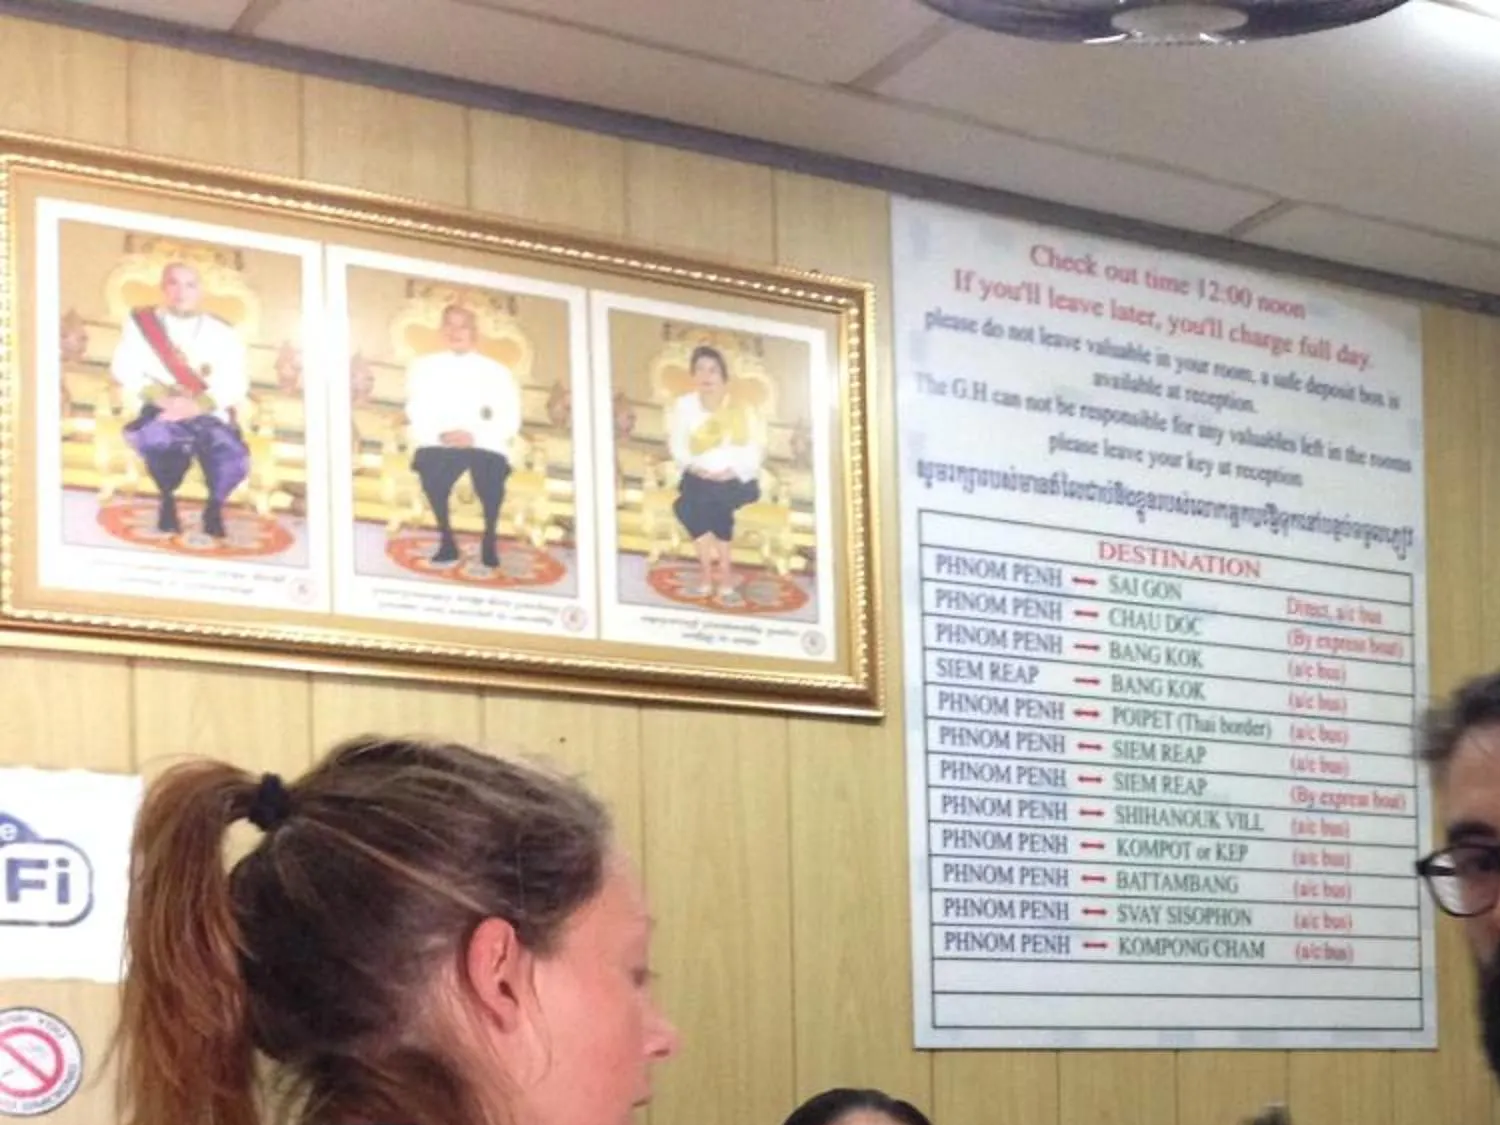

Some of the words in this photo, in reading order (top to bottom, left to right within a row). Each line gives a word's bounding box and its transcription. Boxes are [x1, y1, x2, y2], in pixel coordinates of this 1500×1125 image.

[1030, 245, 1097, 275] Check
[1104, 264, 1138, 285] out
[1145, 271, 1190, 296] time
[1198, 278, 1253, 308] 12:00
[1257, 294, 1307, 319] noon
[954, 268, 975, 292] If
[979, 279, 1041, 305] you'll
[1049, 286, 1104, 317] leave
[1109, 298, 1162, 331] later,
[1168, 313, 1224, 339] you'll
[1229, 323, 1294, 357] charge
[1299, 335, 1332, 361] full
[925, 306, 979, 334] please
[981, 316, 1004, 338] do
[1008, 324, 1035, 343] not
[1038, 325, 1082, 351] leave
[1086, 337, 1152, 365] valuable
[1155, 350, 1171, 367] in
[1174, 355, 1209, 374] your
[1260, 372, 1270, 386] a
[1273, 372, 1303, 391] safe
[1305, 375, 1356, 401] deposit
[1388, 395, 1400, 411] is
[1092, 371, 1162, 397] available
[1166, 383, 1181, 400] at
[916, 371, 947, 396] The
[951, 377, 988, 402] G.H
[991, 390, 1022, 408] can
[1025, 394, 1052, 413] not
[1056, 395, 1077, 417] be
[1079, 403, 1168, 432] responsible
[1172, 415, 1194, 436] for
[1197, 424, 1224, 446] any
[1229, 428, 1298, 453] valuables
[1300, 434, 1324, 458] left
[1327, 441, 1342, 461] in
[1345, 444, 1367, 465] the
[1369, 453, 1412, 473] rooms
[1048, 432, 1099, 455] please
[1103, 438, 1143, 462] leave
[1148, 450, 1183, 468] your
[1186, 450, 1213, 478] key
[1217, 460, 1232, 477] at
[935, 553, 1007, 581] PHNOM
[1012, 563, 1063, 588] PENH
[1098, 541, 1262, 578] DESTINATION
[935, 588, 1007, 615] PHNOM
[1012, 597, 1063, 622] PENH
[1107, 606, 1161, 632] CHAU
[1165, 613, 1204, 637] DOC
[935, 622, 1008, 649] PHNOM
[1012, 630, 1063, 655] PENH
[1286, 627, 1312, 651] (By
[1316, 636, 1367, 655] express
[1108, 640, 1161, 664] BANG
[1165, 646, 1204, 669] KOK
[935, 656, 984, 681] SIEM
[989, 663, 1040, 685] REAP
[1111, 673, 1162, 697] BANG
[1167, 678, 1206, 701] KOK
[938, 690, 1010, 717] PHNOM
[1014, 697, 1065, 721] PENH
[1112, 705, 1174, 731] POIPET
[1176, 711, 1216, 734] (Thai
[1218, 714, 1272, 741] border)
[939, 725, 1011, 750] PHNOM
[1015, 730, 1066, 753] PENH
[1112, 739, 1157, 762] SIEM
[1161, 743, 1208, 765] REAP
[940, 759, 1012, 785] PHNOM
[1015, 765, 1067, 788] PENH
[1112, 771, 1157, 794] SIEM
[1161, 775, 1209, 797] REAP
[941, 793, 1012, 818] PHNOM
[1017, 798, 1068, 821] PENH
[1319, 791, 1370, 809] express
[1114, 804, 1221, 830] SHIHANOUK
[1225, 811, 1265, 832] VILL
[942, 828, 1013, 851] PHNOM
[1018, 832, 1069, 854] PENH
[1115, 837, 1192, 861] KOMPOT
[1196, 846, 1212, 862] or
[1215, 842, 1250, 863] KEP
[5, 857, 70, 904] Fi
[943, 862, 1014, 885] PHNOM
[1019, 865, 1069, 888] PENH
[1115, 870, 1240, 895] BATTAMBANG
[943, 897, 1015, 920] PHNOM
[1019, 899, 1070, 922] PENH
[1116, 903, 1163, 925] SVAY
[1166, 904, 1253, 927] SISOPHON
[944, 931, 1016, 953] PHNOM
[1021, 933, 1071, 955] PENH
[1118, 936, 1209, 959] KOMPONG
[1212, 939, 1266, 960] CHAM
